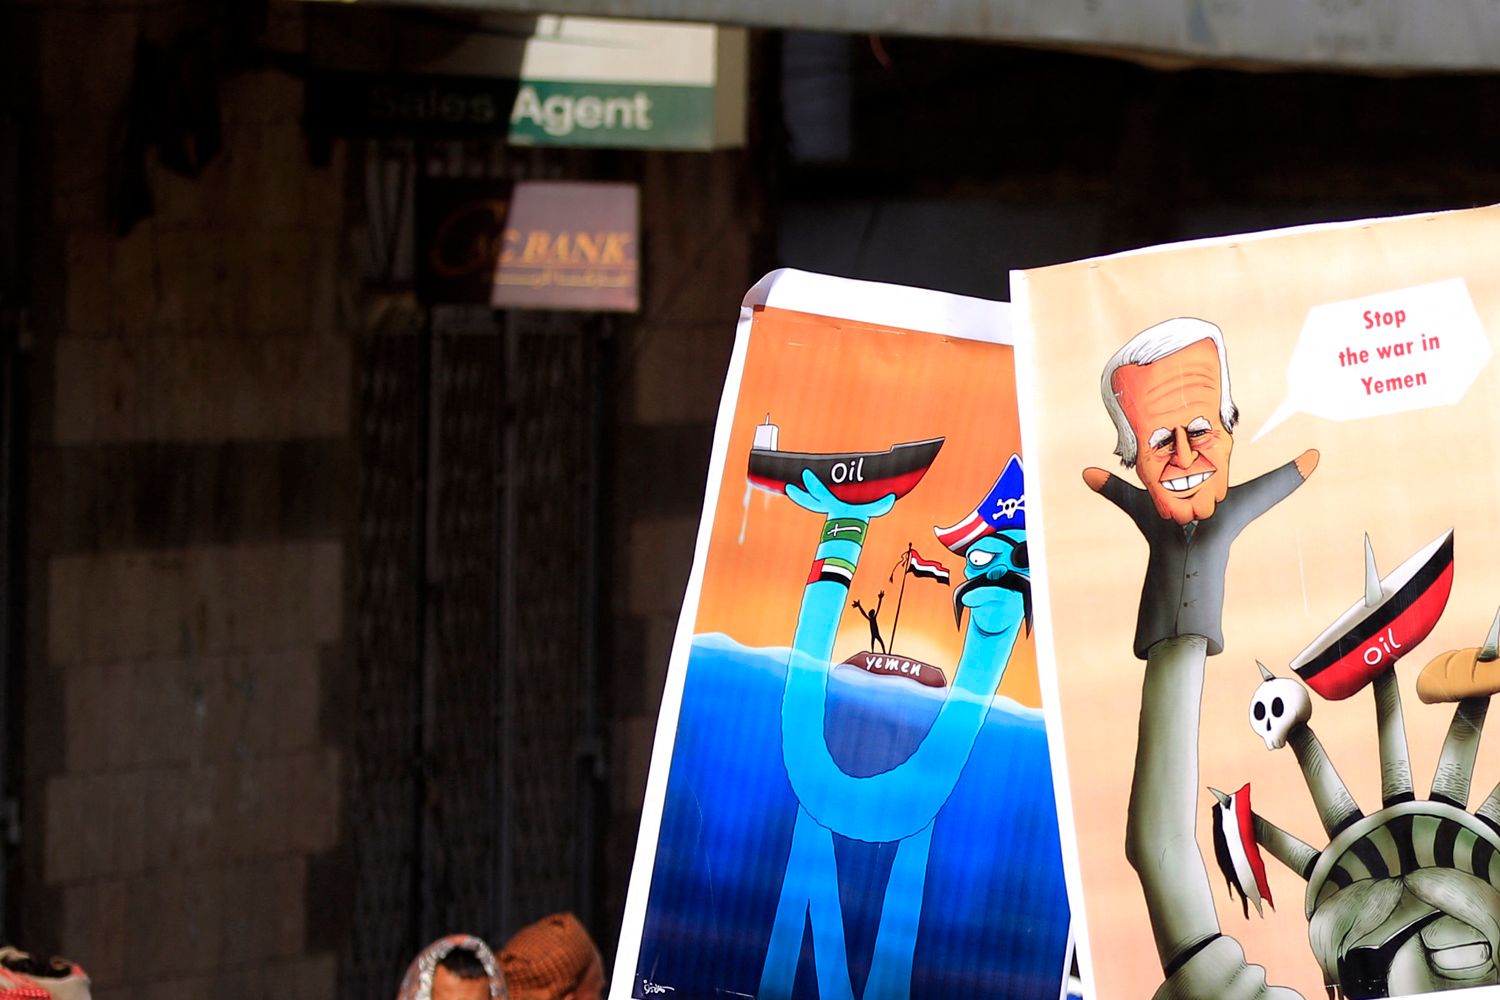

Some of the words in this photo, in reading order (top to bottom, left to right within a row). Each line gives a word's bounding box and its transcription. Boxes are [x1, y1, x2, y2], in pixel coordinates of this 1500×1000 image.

[510, 86, 653, 136] Agent
[523, 229, 632, 265] BANK
[1363, 309, 1407, 330] Stop
[1338, 346, 1370, 368] the
[1376, 341, 1414, 360] war
[1421, 333, 1441, 352] in
[1361, 371, 1427, 396] Yemen
[831, 457, 865, 484] Oil
